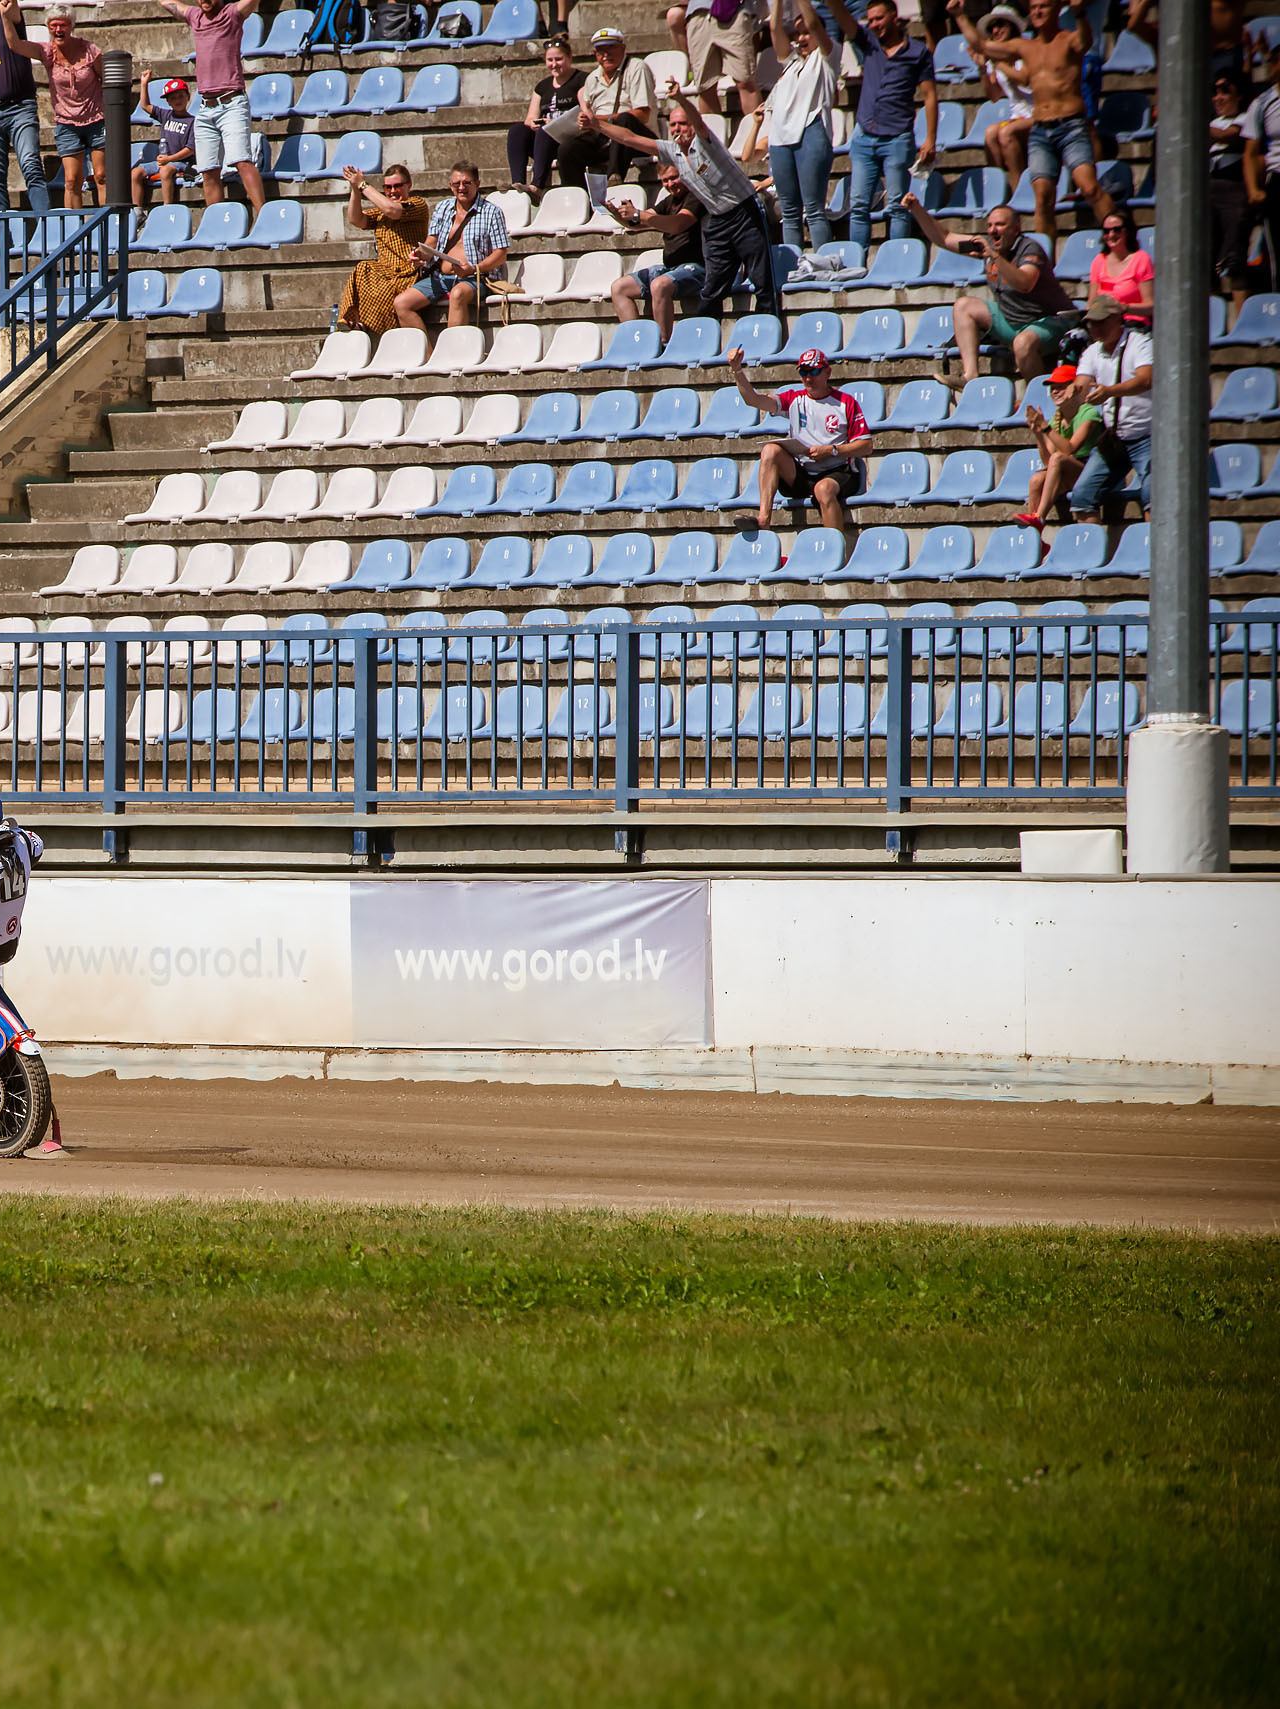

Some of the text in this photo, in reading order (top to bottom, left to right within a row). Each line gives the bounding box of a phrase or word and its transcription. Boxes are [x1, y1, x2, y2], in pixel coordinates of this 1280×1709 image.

[270, 81, 277, 95] 3
[325, 77, 332, 90] 4
[358, 139, 366, 150] 6
[169, 214, 175, 223] 4
[143, 277, 149, 291] 5
[198, 275, 207, 287] 6
[815, 320, 823, 333] 9
[874, 315, 889, 329] 10
[938, 316, 949, 328] 11
[633, 330, 640, 343] 6
[695, 327, 702, 337] 7
[752, 323, 760, 338] 8
[920, 389, 932, 401] 12
[981, 385, 997, 398] 13
[553, 402, 559, 413] 6
[614, 401, 621, 412] 7
[651, 467, 657, 478] 9
[713, 468, 723, 480] 10
[963, 463, 975, 474] 14
[470, 472, 476, 484] 6
[531, 472, 537, 483] 7
[942, 536, 954, 548] 15
[1009, 534, 1024, 548] 16
[1075, 531, 1090, 546] 17
[567, 543, 573, 554] 9
[625, 544, 637, 557] 10
[687, 545, 700, 556] 11
[751, 542, 762, 554] 12
[814, 540, 825, 552] 13
[446, 547, 452, 558] 7
[503, 549, 510, 560] 8
[274, 697, 280, 708] 7
[455, 697, 468, 708] 10
[578, 697, 589, 709] 12
[643, 696, 655, 708] 13
[771, 696, 783, 708] 15
[45, 938, 307, 986] www.gorod.lv
[395, 939, 668, 991] www.gorod.lv
